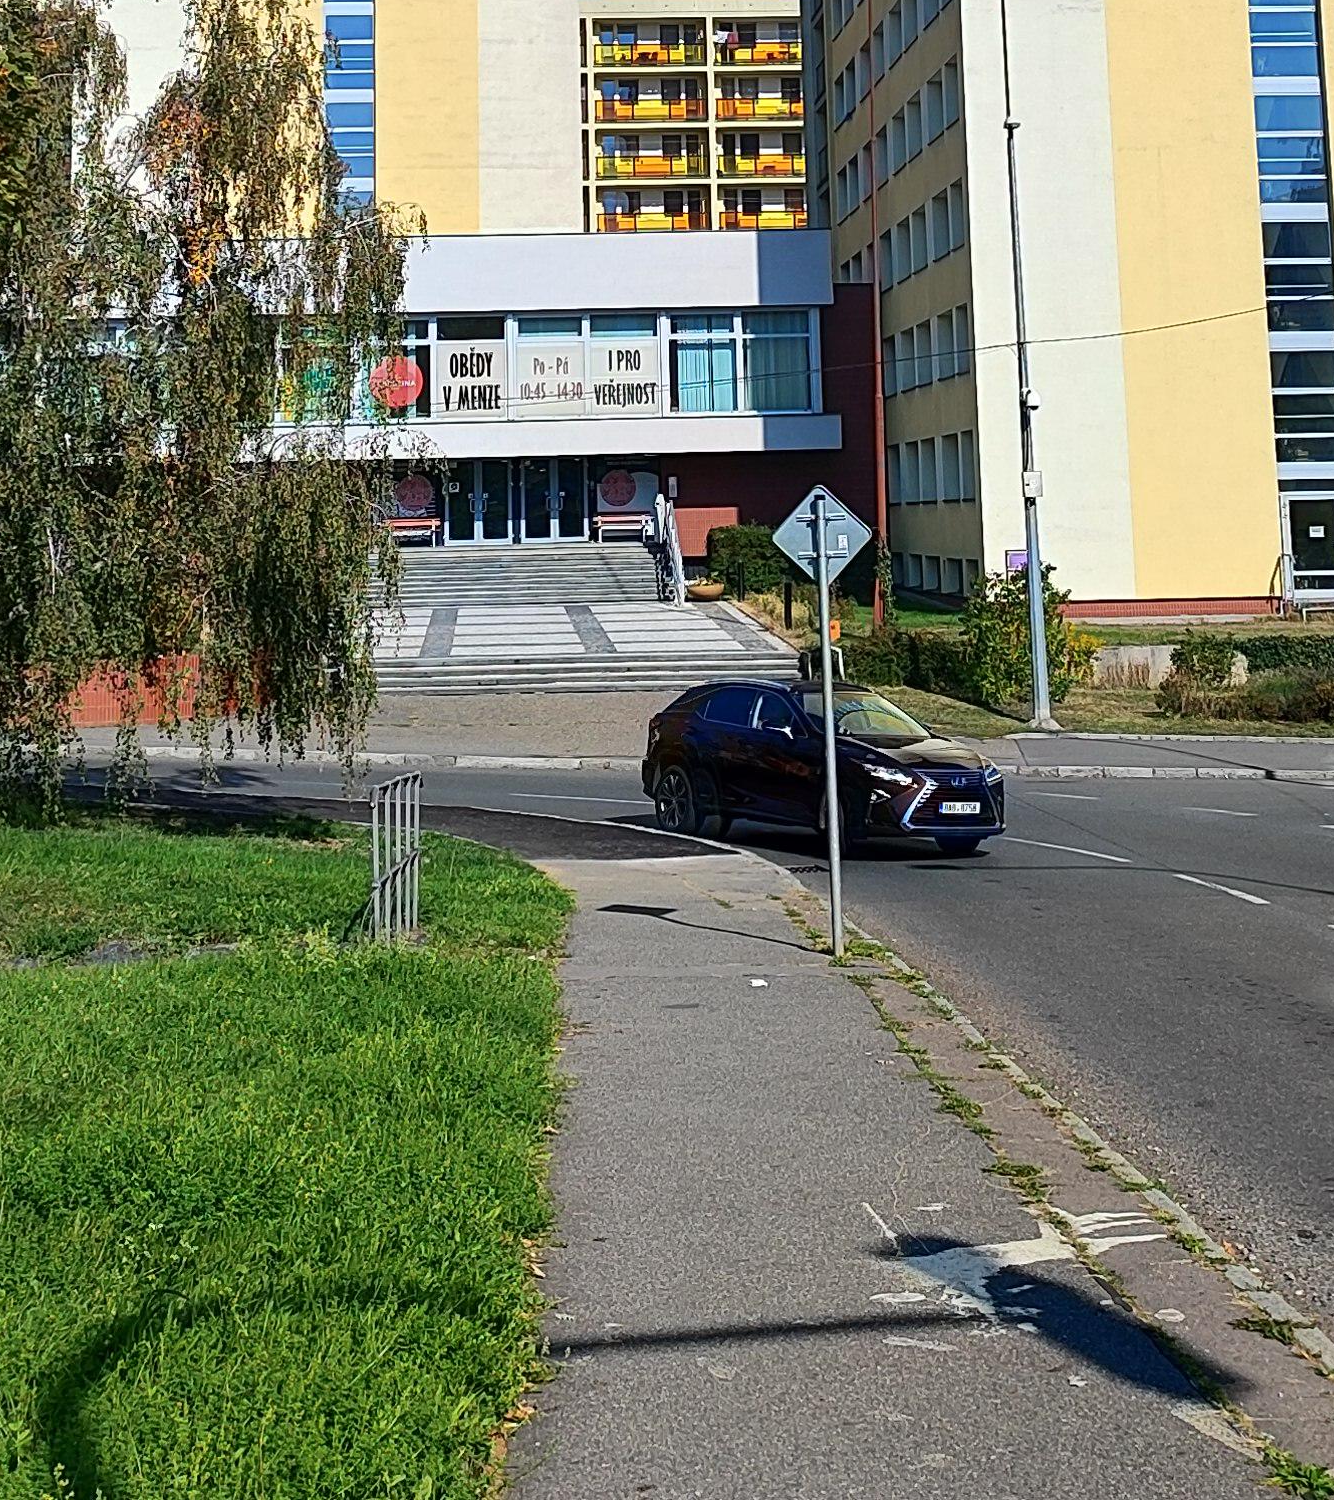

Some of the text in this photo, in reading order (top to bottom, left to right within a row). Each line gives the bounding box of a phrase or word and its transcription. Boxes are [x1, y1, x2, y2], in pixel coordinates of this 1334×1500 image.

[449, 346, 494, 378] OBĚDY
[533, 357, 545, 375] Po
[556, 356, 569, 375] Pá
[608, 349, 641, 372] I PRO
[442, 384, 501, 411] V MENZE
[593, 378, 657, 408] VEŘEJNOST
